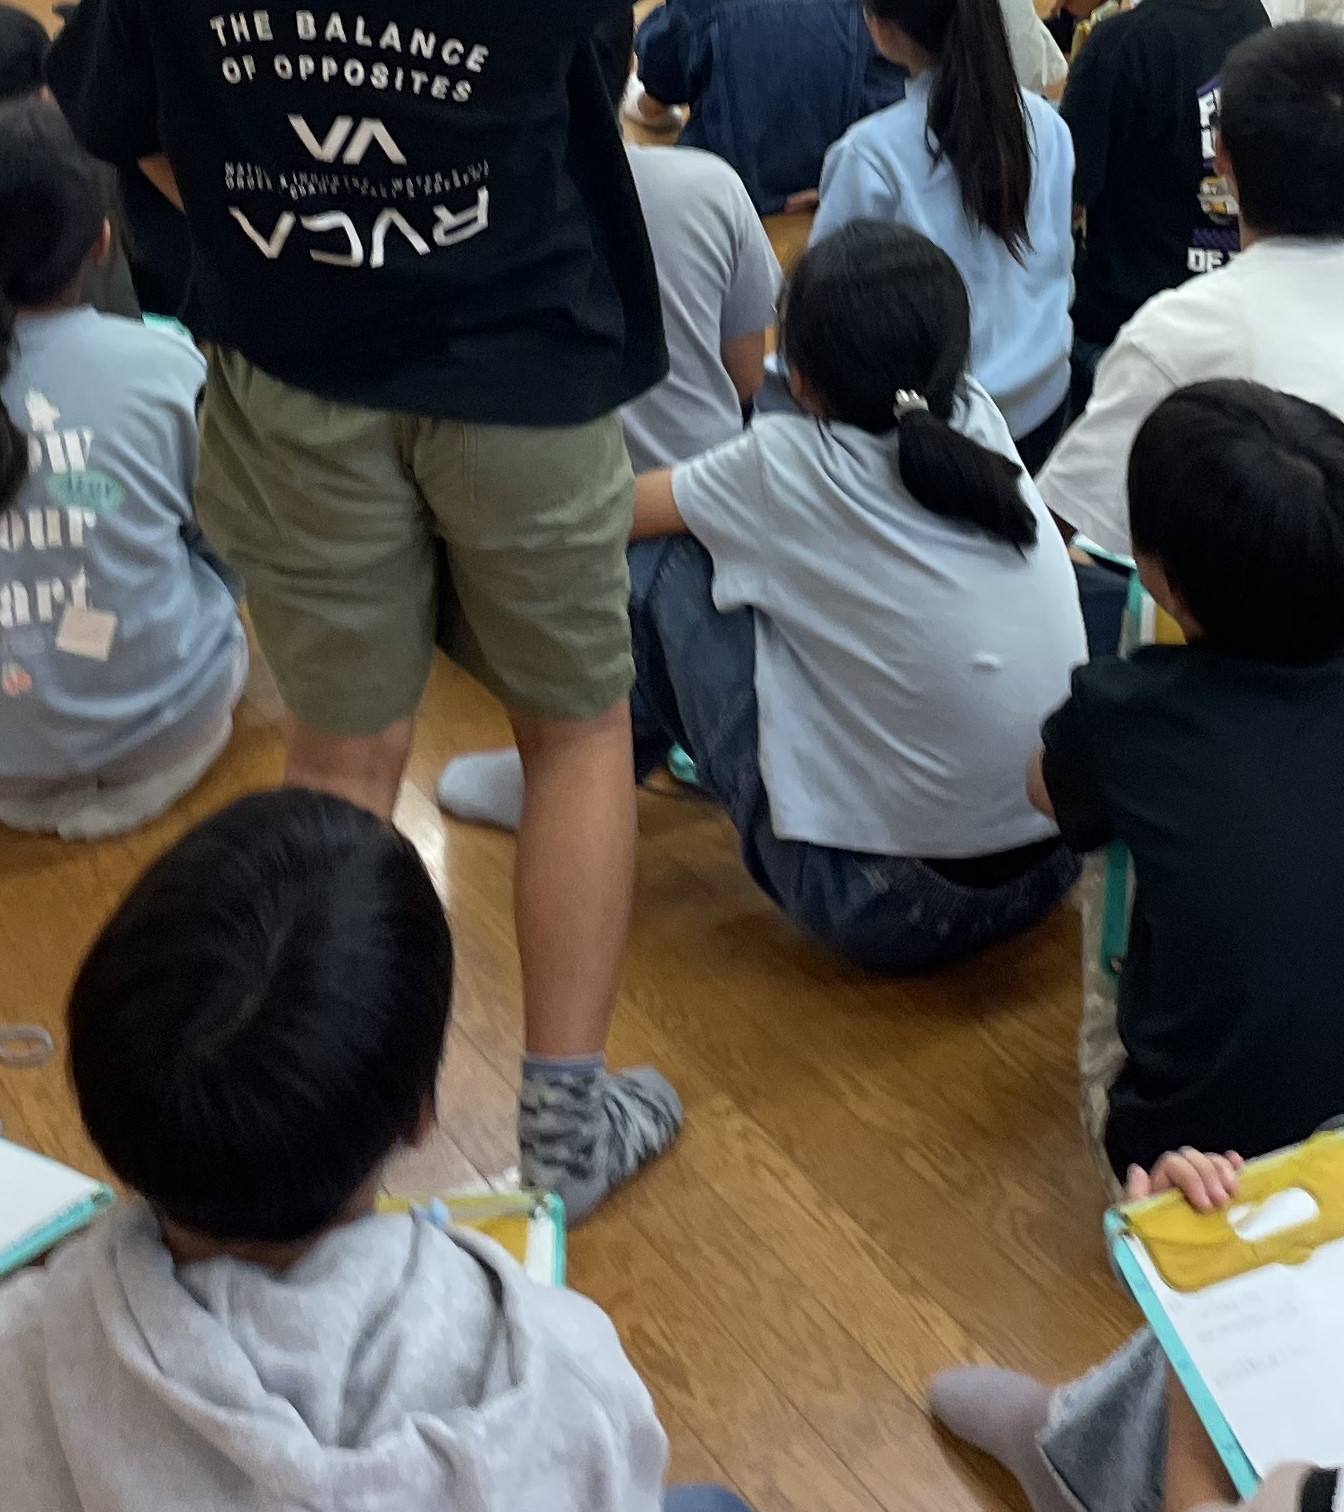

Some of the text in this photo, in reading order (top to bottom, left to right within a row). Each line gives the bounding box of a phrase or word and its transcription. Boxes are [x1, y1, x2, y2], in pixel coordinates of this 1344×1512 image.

[209, 9, 489, 73] THE BALANCE
[221, 54, 472, 102] OF OPPOSITES
